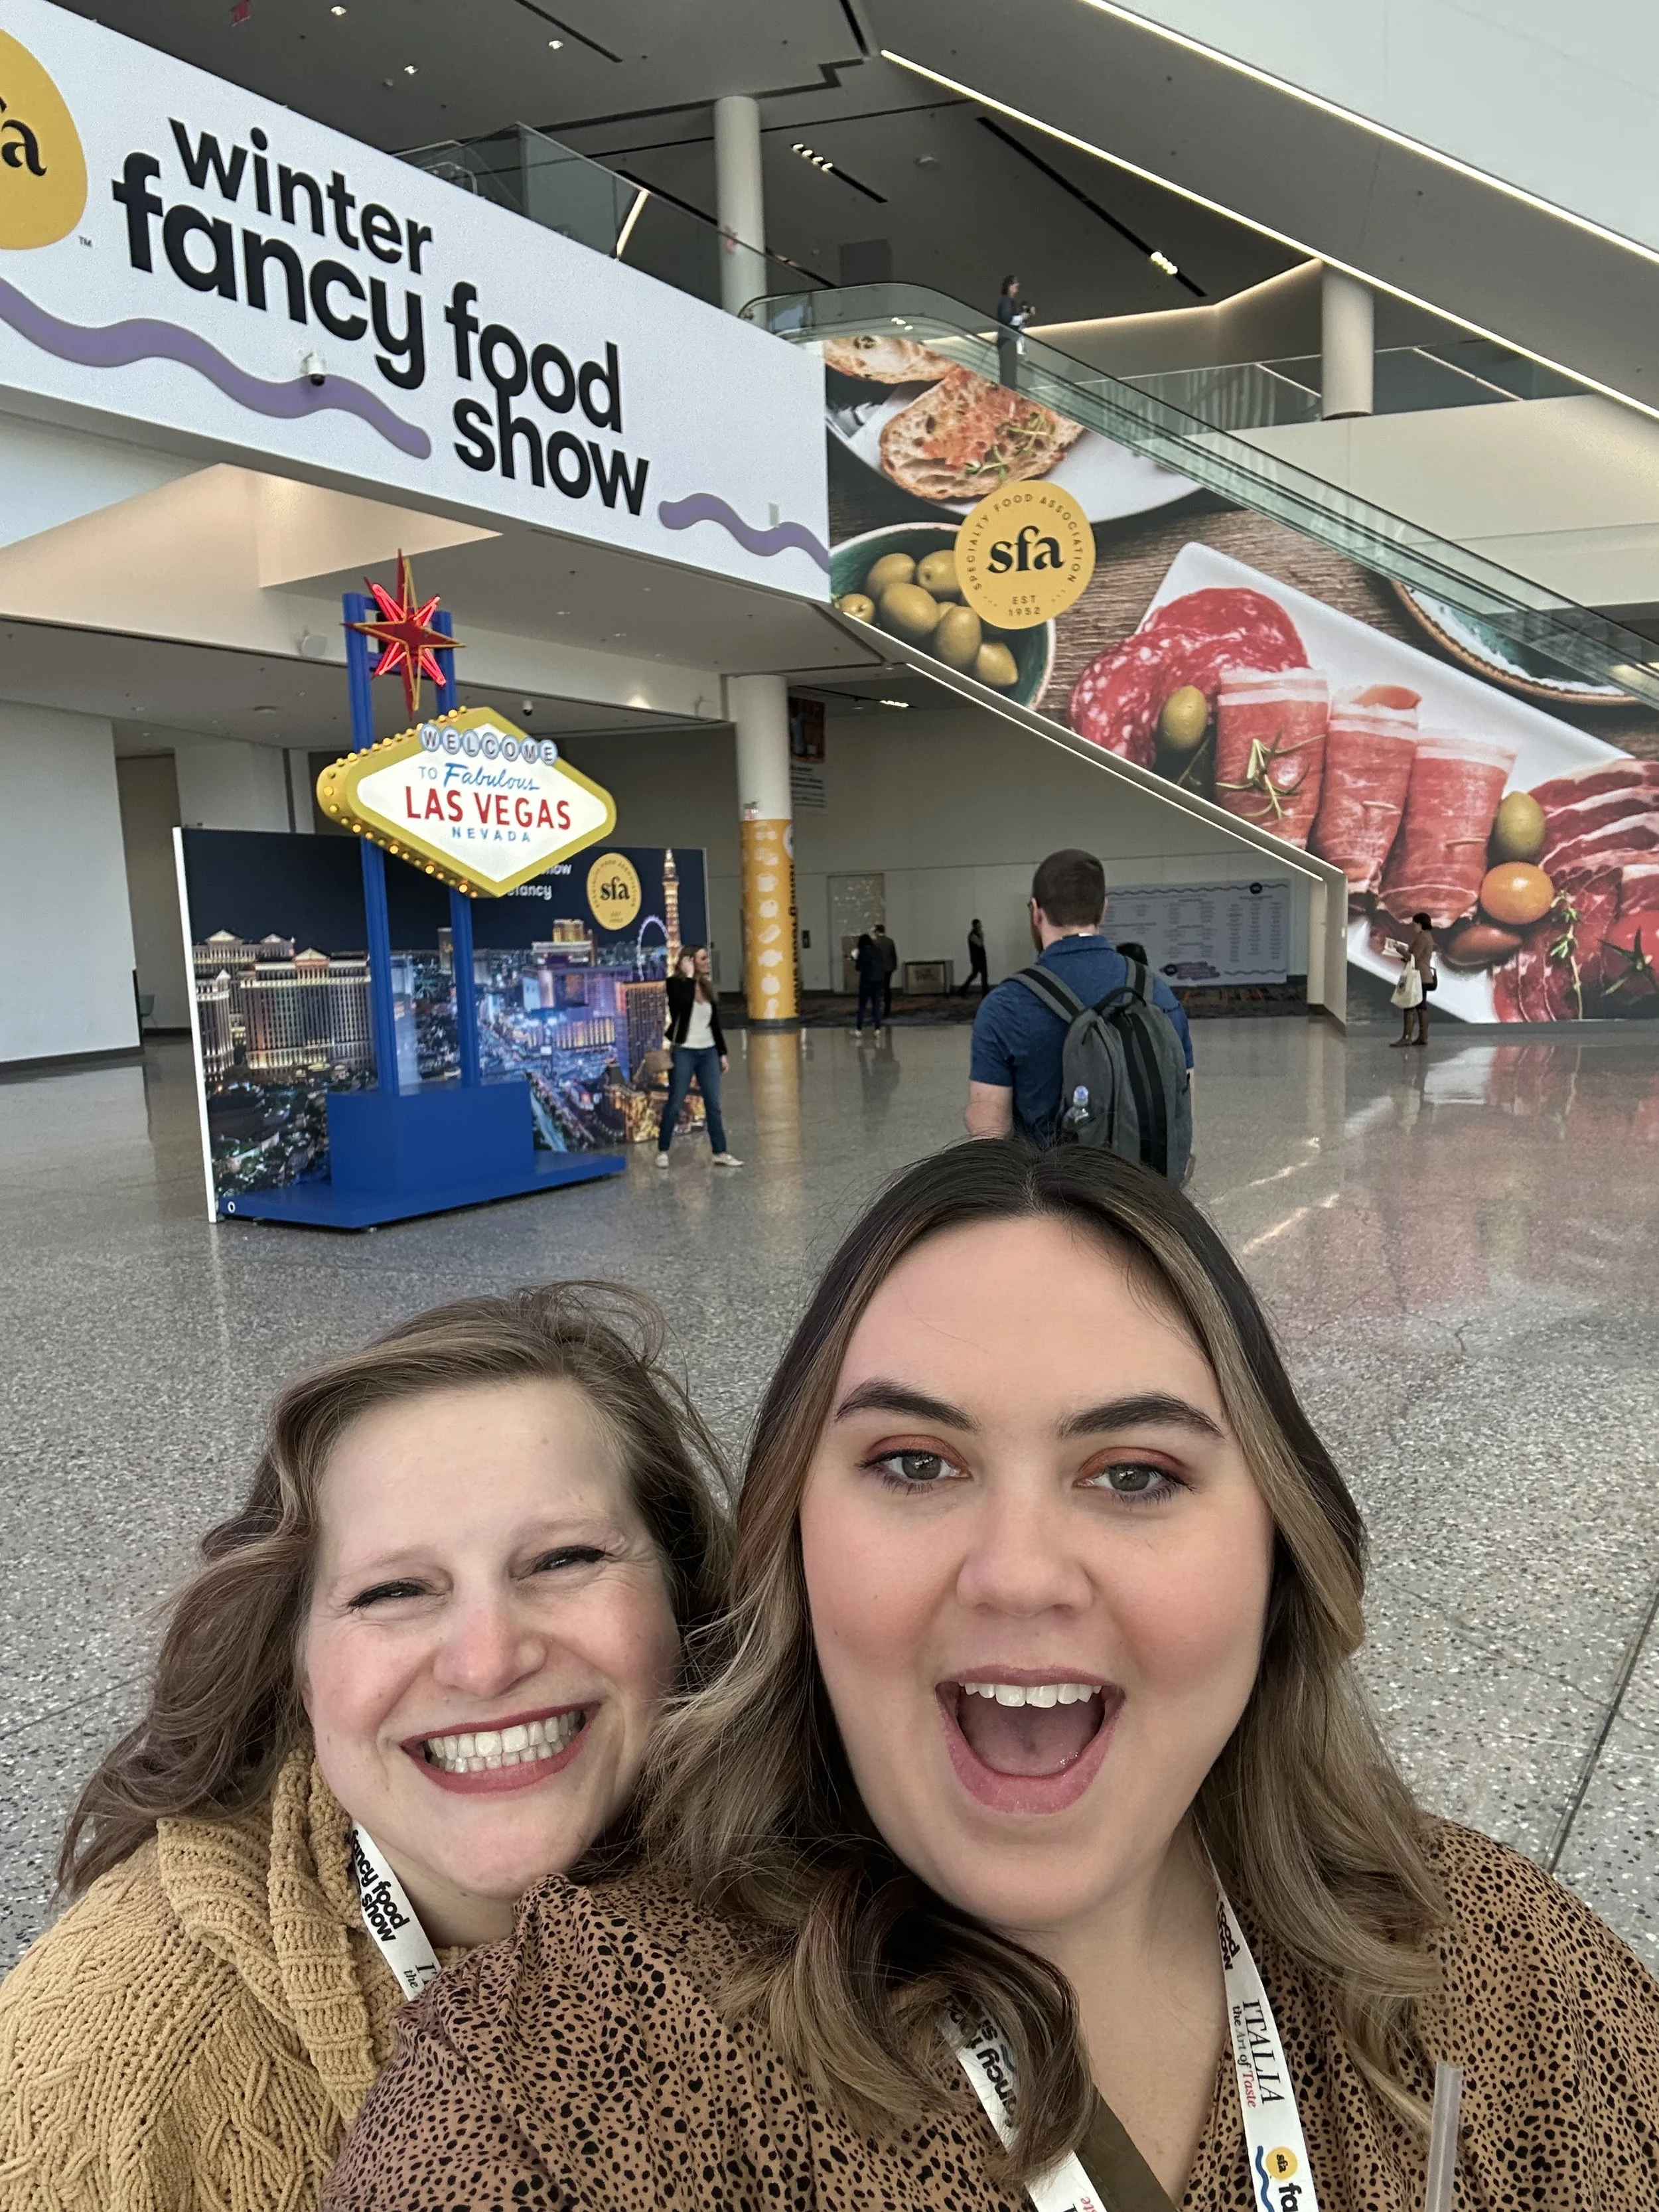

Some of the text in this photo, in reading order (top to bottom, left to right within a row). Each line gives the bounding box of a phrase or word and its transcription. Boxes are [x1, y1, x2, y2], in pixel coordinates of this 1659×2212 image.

[0, 98, 47, 177] a
[168, 117, 433, 274] winter
[112, 152, 622, 433] fancy food
[453, 392, 650, 516] show
[966, 493, 1084, 590] SPECIALTY FOOD ASSOCIATION
[986, 525, 1066, 573] sfa
[1008, 607, 1041, 616] 1952
[1012, 595, 1036, 605] EST
[423, 729, 554, 763] WELCOME
[418, 762, 540, 791] TO Fabulous
[405, 786, 571, 831] LAS VEGAS
[452, 827, 531, 842] NEVADA
[600, 875, 630, 901] sfa
[352, 1829, 410, 1929] fancy food
[362, 1893, 396, 1942] show
[403, 1968, 418, 1989] the
[1232, 2006, 1257, 2108] the Art of Taste
[1242, 1999, 1285, 2104] ITALIA
